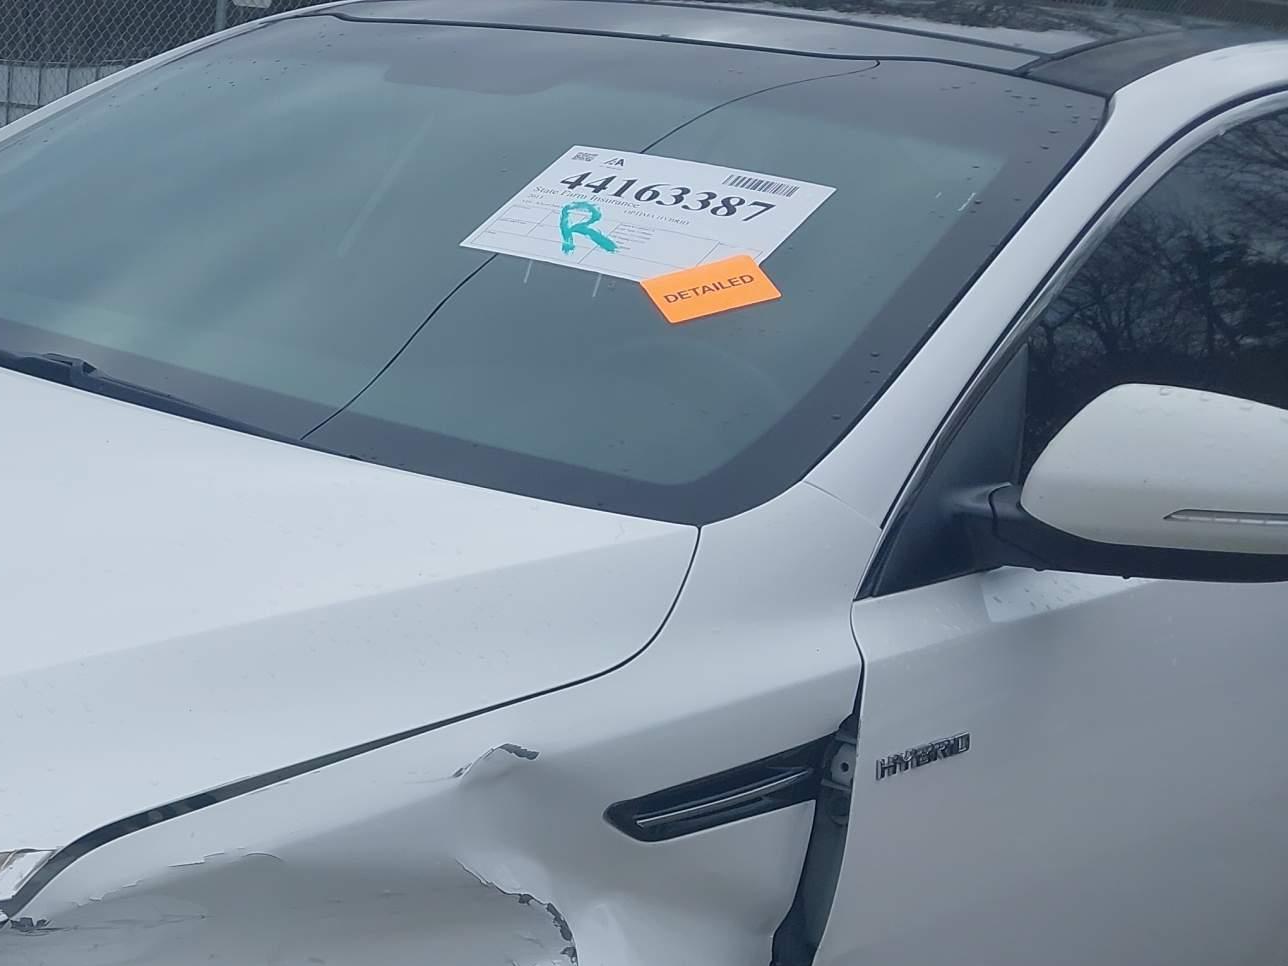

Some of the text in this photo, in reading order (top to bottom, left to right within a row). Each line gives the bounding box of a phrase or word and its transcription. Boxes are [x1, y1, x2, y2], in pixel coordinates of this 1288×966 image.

[533, 185, 640, 209] State Farm Insurance
[560, 171, 777, 222] 44163387
[559, 201, 619, 255] R
[663, 272, 755, 306] DETAILED
[875, 732, 971, 781] HYBRID
